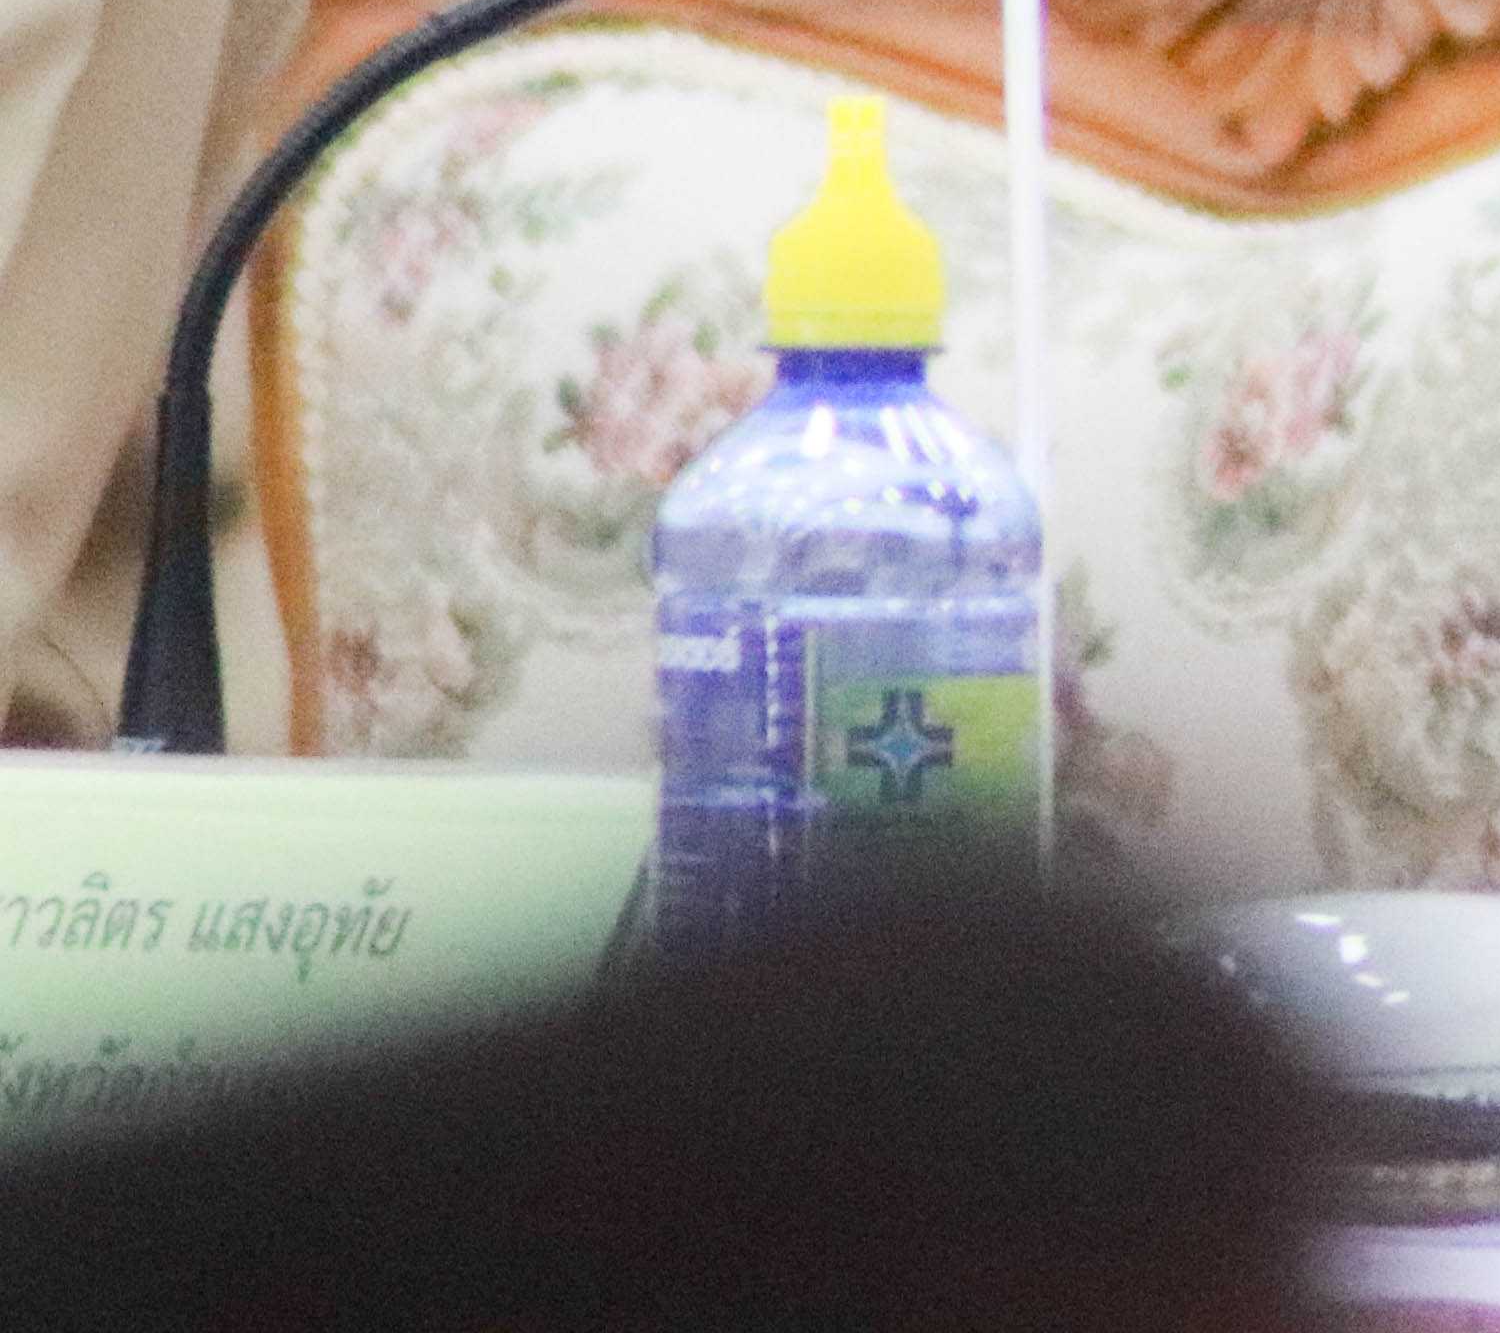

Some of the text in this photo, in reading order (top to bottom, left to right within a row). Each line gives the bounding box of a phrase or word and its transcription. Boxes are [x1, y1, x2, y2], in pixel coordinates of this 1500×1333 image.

[0, 869, 411, 986] าวลิตร แสงอุทัย
